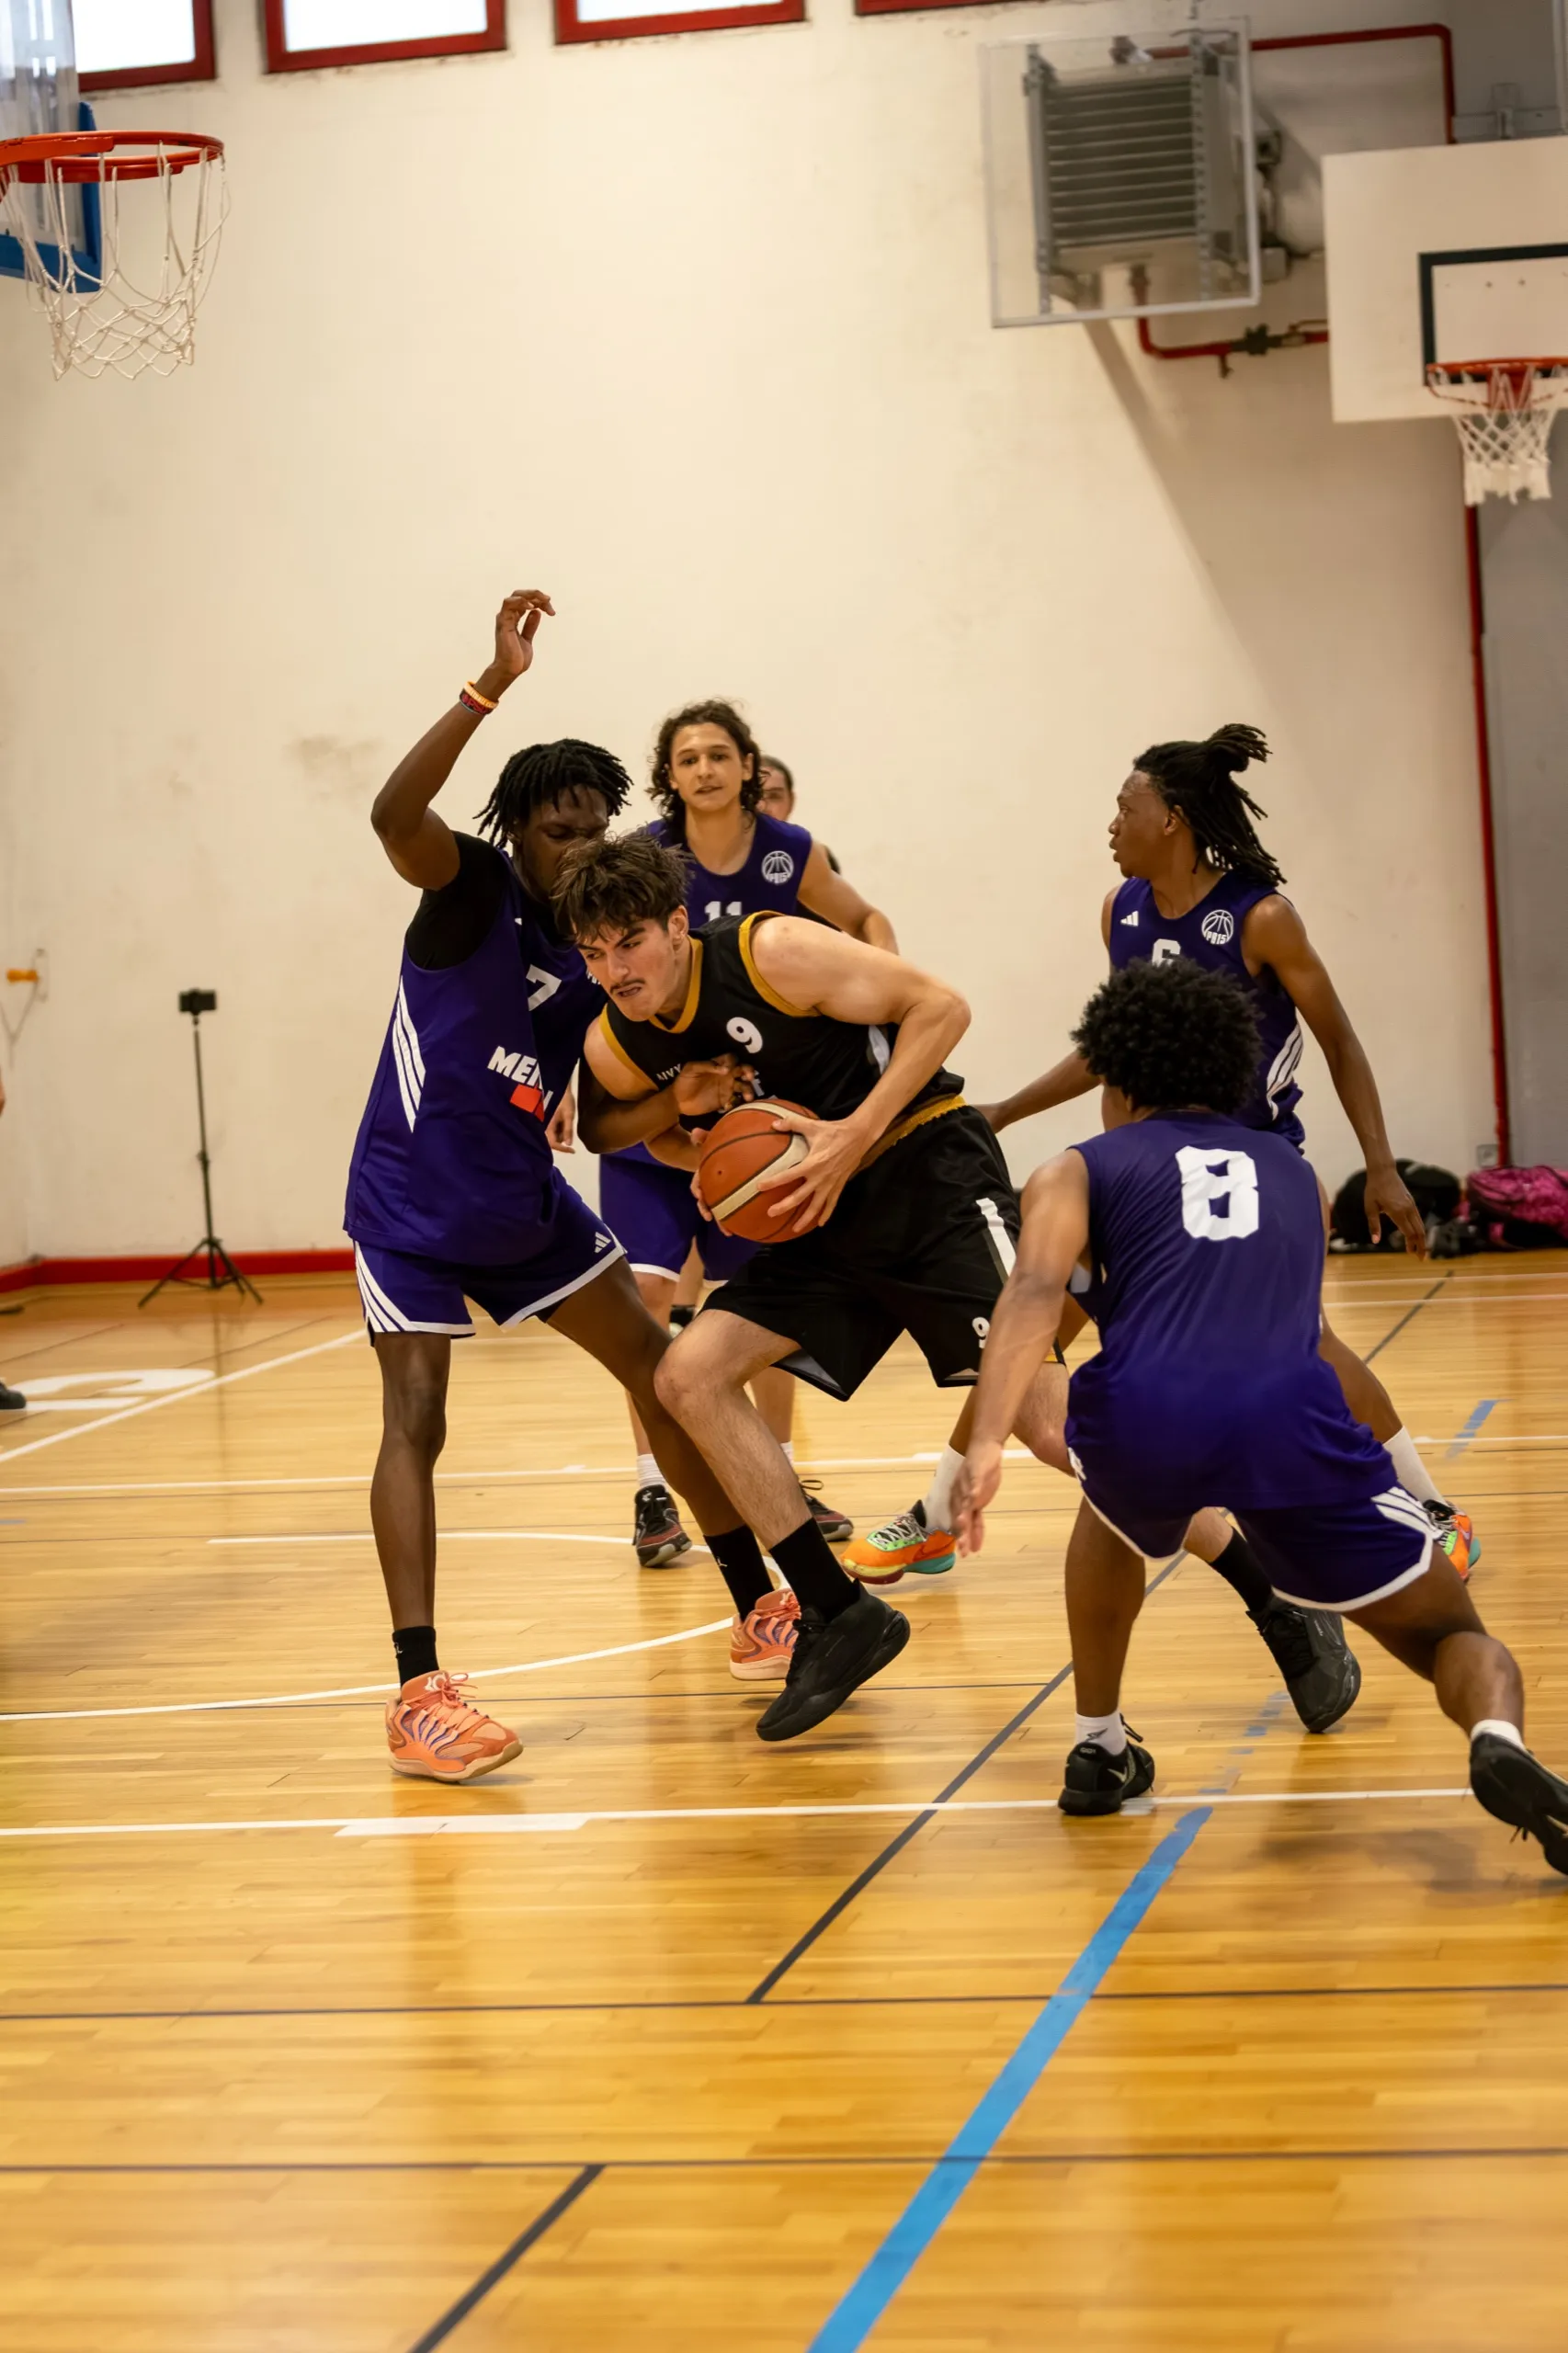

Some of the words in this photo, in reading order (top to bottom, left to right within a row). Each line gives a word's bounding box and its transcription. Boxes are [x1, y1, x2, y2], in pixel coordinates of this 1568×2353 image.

[526, 963, 562, 1012] 7
[726, 1017, 763, 1054] 9
[1175, 1145, 1259, 1241] 8
[971, 1316, 991, 1349] 9
